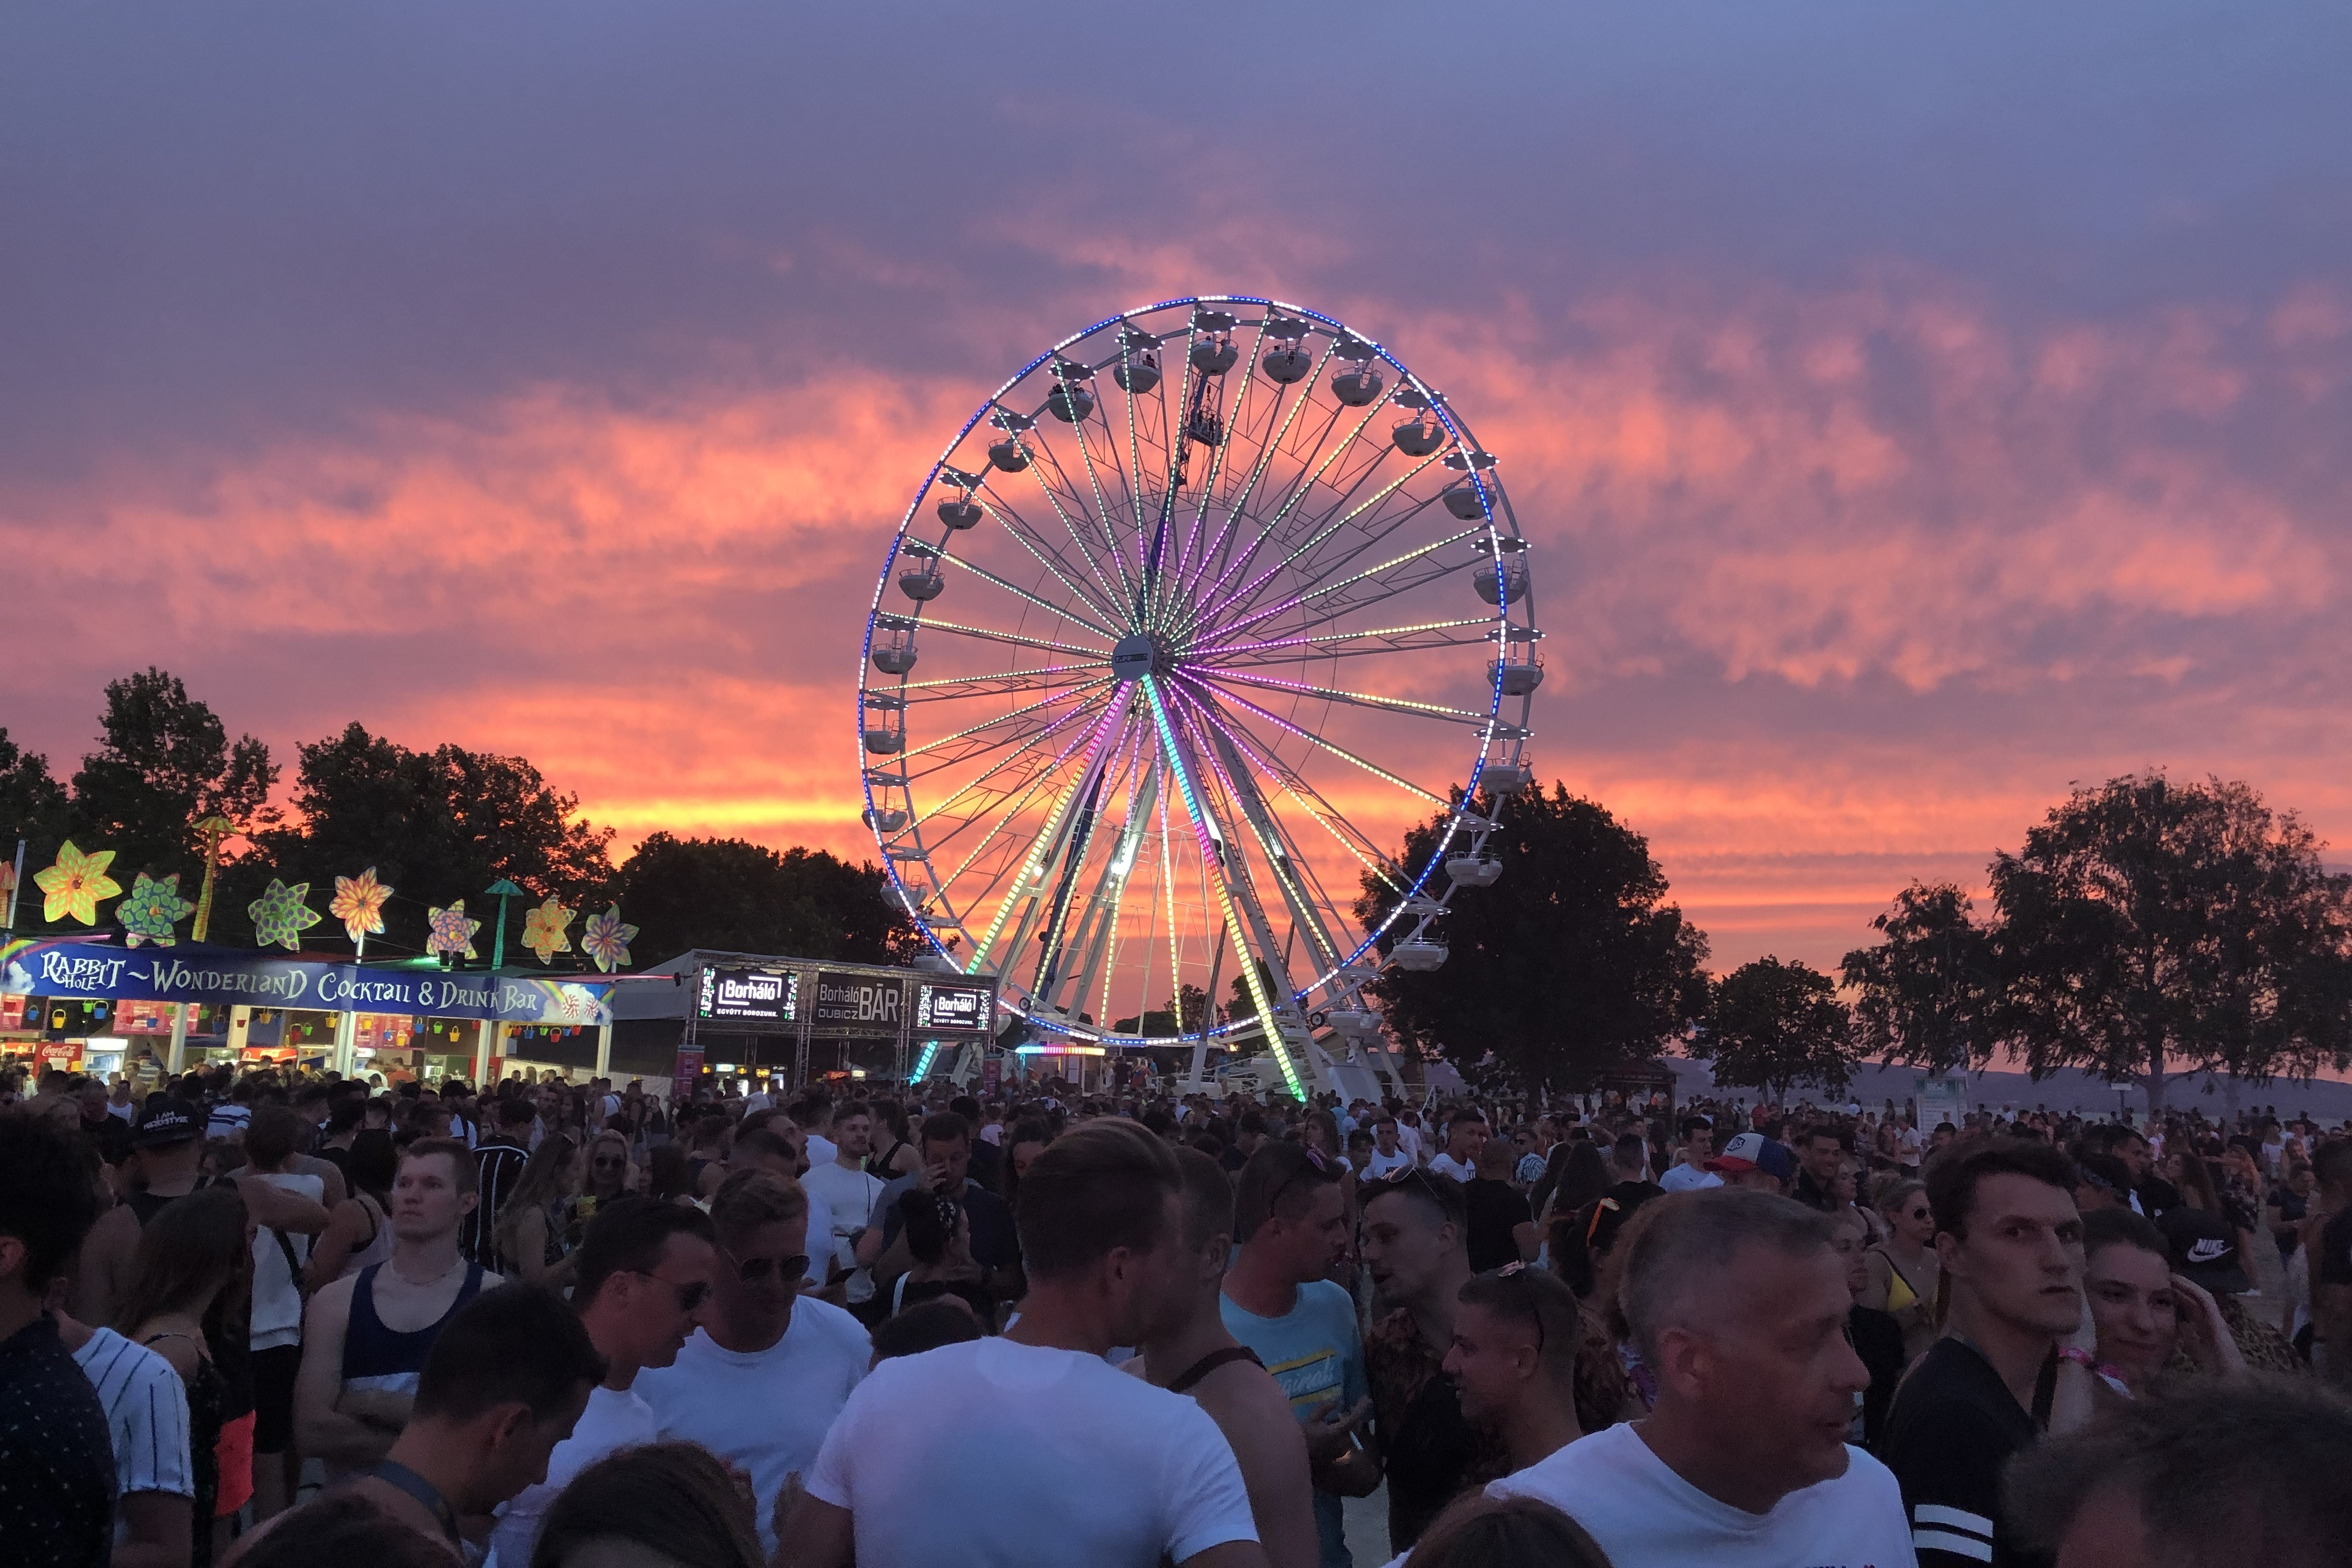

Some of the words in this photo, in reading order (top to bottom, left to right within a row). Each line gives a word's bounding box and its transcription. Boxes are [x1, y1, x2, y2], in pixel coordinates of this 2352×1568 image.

[418, 981, 435, 1006] &
[725, 980, 775, 1000] Borháló
[820, 984, 859, 1003] Borháló
[938, 996, 972, 1012] Borháló
[818, 1008, 858, 1020] DUBICZ
[2194, 1238, 2224, 1253] NIKE
